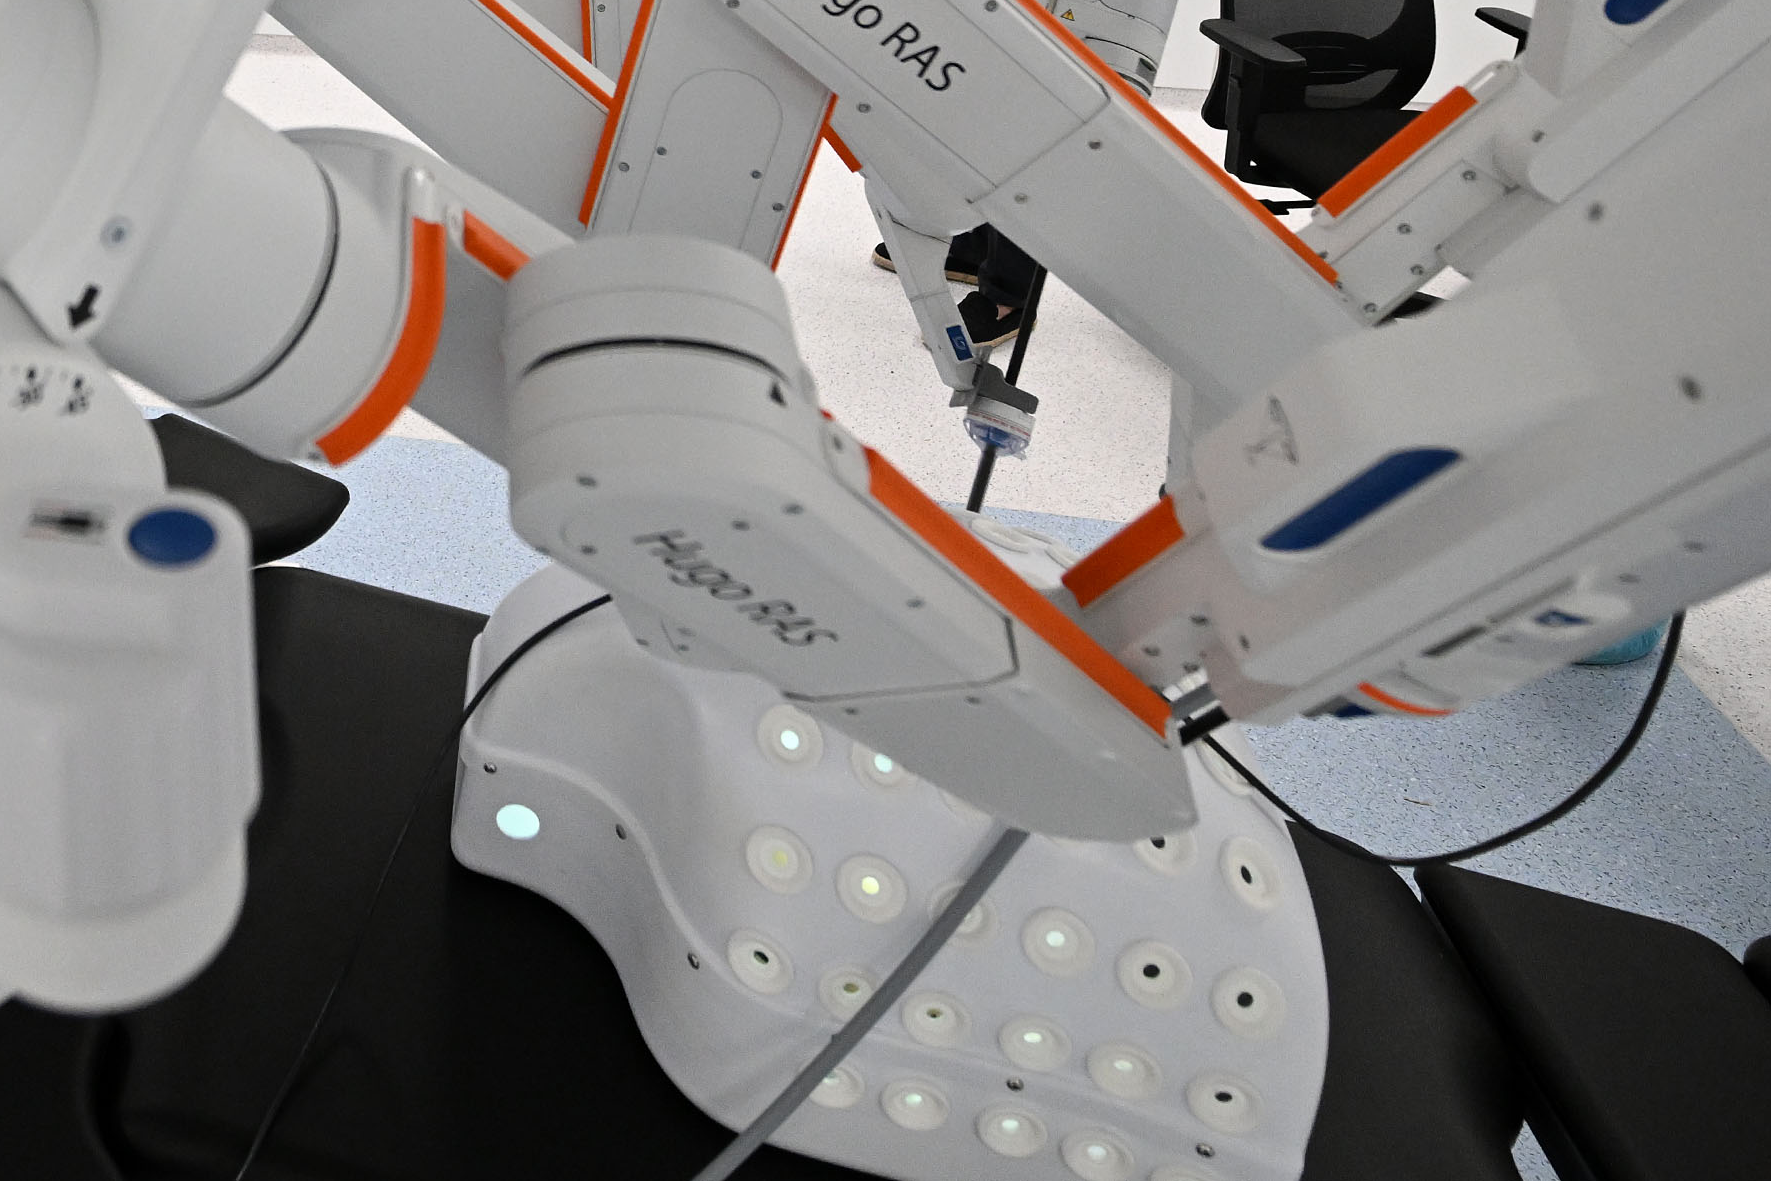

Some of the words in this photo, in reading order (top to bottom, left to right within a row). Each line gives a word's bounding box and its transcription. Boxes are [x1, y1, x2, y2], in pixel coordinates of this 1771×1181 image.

[880, 21, 966, 91] RAS
[633, 529, 754, 600] Hugo
[737, 599, 839, 647] RAS
